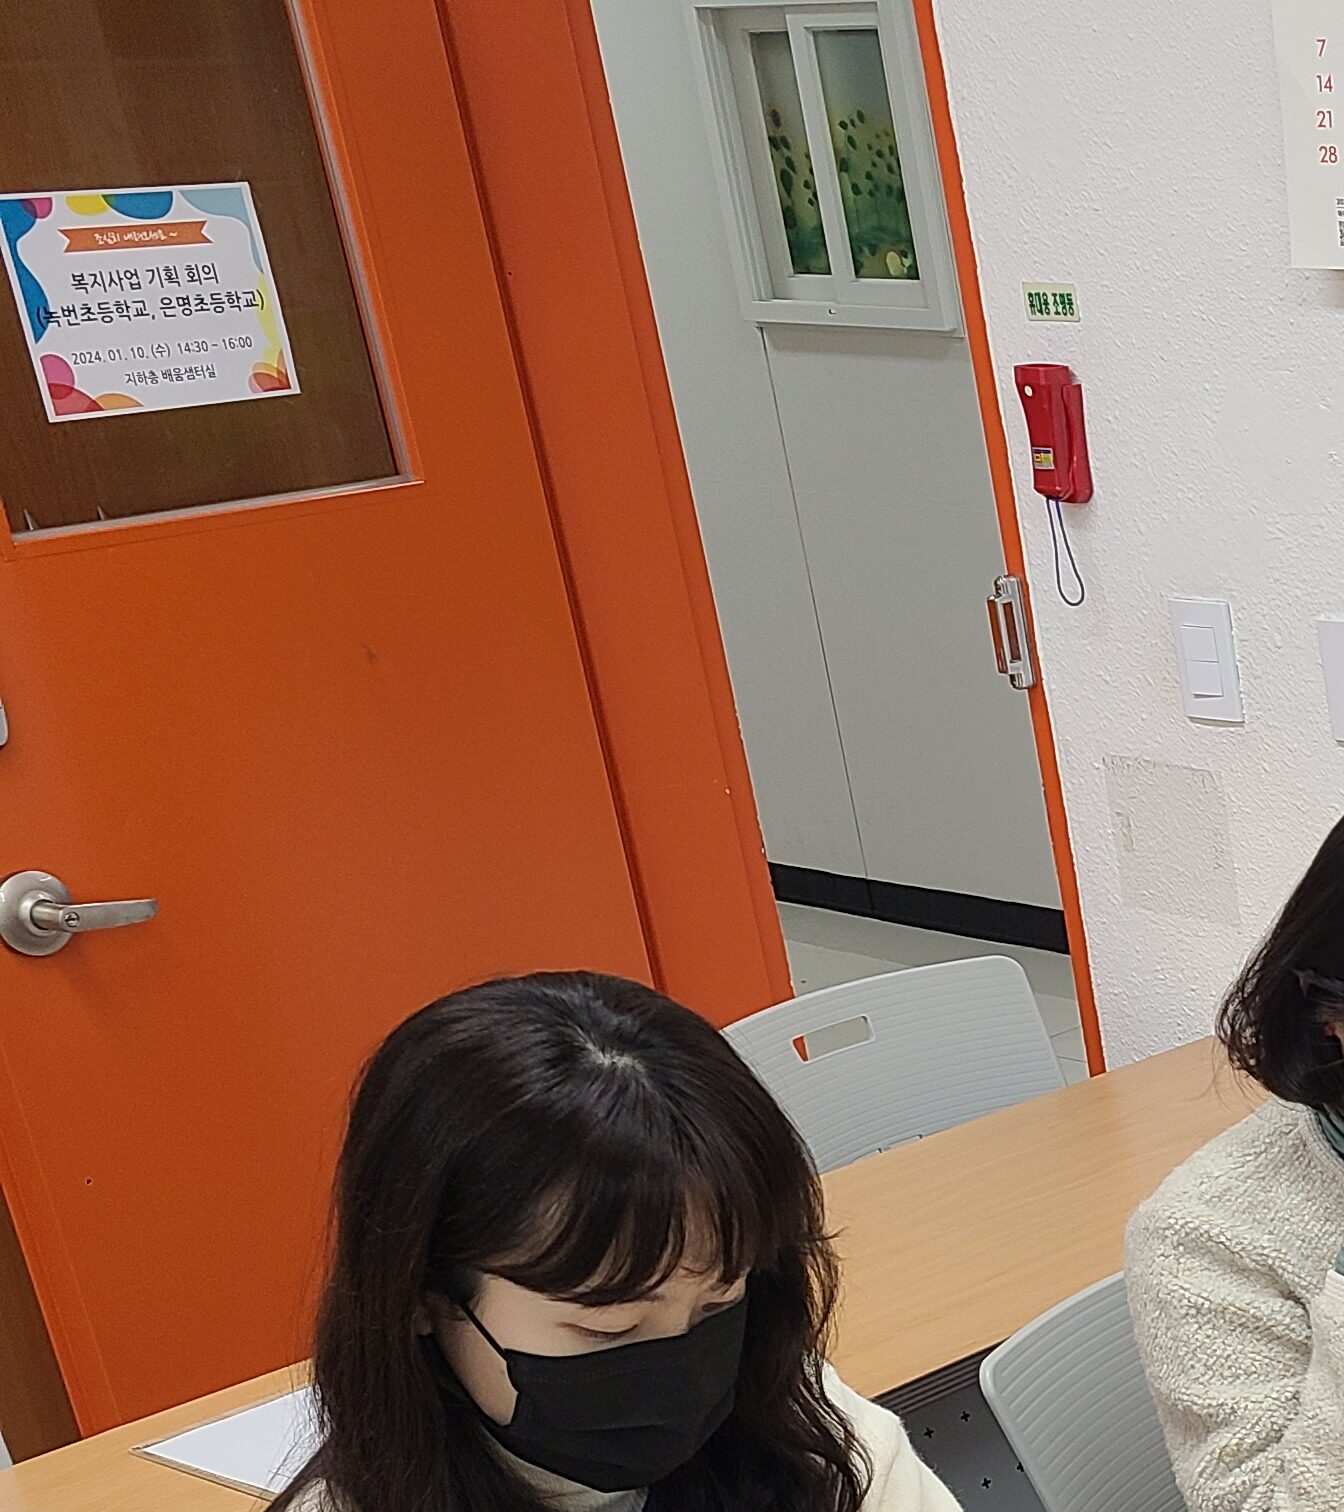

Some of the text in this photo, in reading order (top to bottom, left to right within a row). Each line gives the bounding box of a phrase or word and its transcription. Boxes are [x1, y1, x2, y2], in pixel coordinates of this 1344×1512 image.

[1316, 40, 1326, 56] 7
[1316, 75, 1333, 92] 14
[1317, 111, 1332, 127] 21
[1319, 146, 1338, 163] 28
[71, 263, 220, 294] 복지사업 기획 회의
[36, 289, 264, 328] (녹번초등학교, 은명초등학교)
[1028, 292, 1074, 316] 휴대용 조명등
[72, 351, 106, 365] 2024.
[108, 350, 128, 362] 01.
[177, 341, 208, 354] 14:30
[222, 337, 252, 350] 16:00
[125, 364, 216, 386] 지하층 배움샘터실
